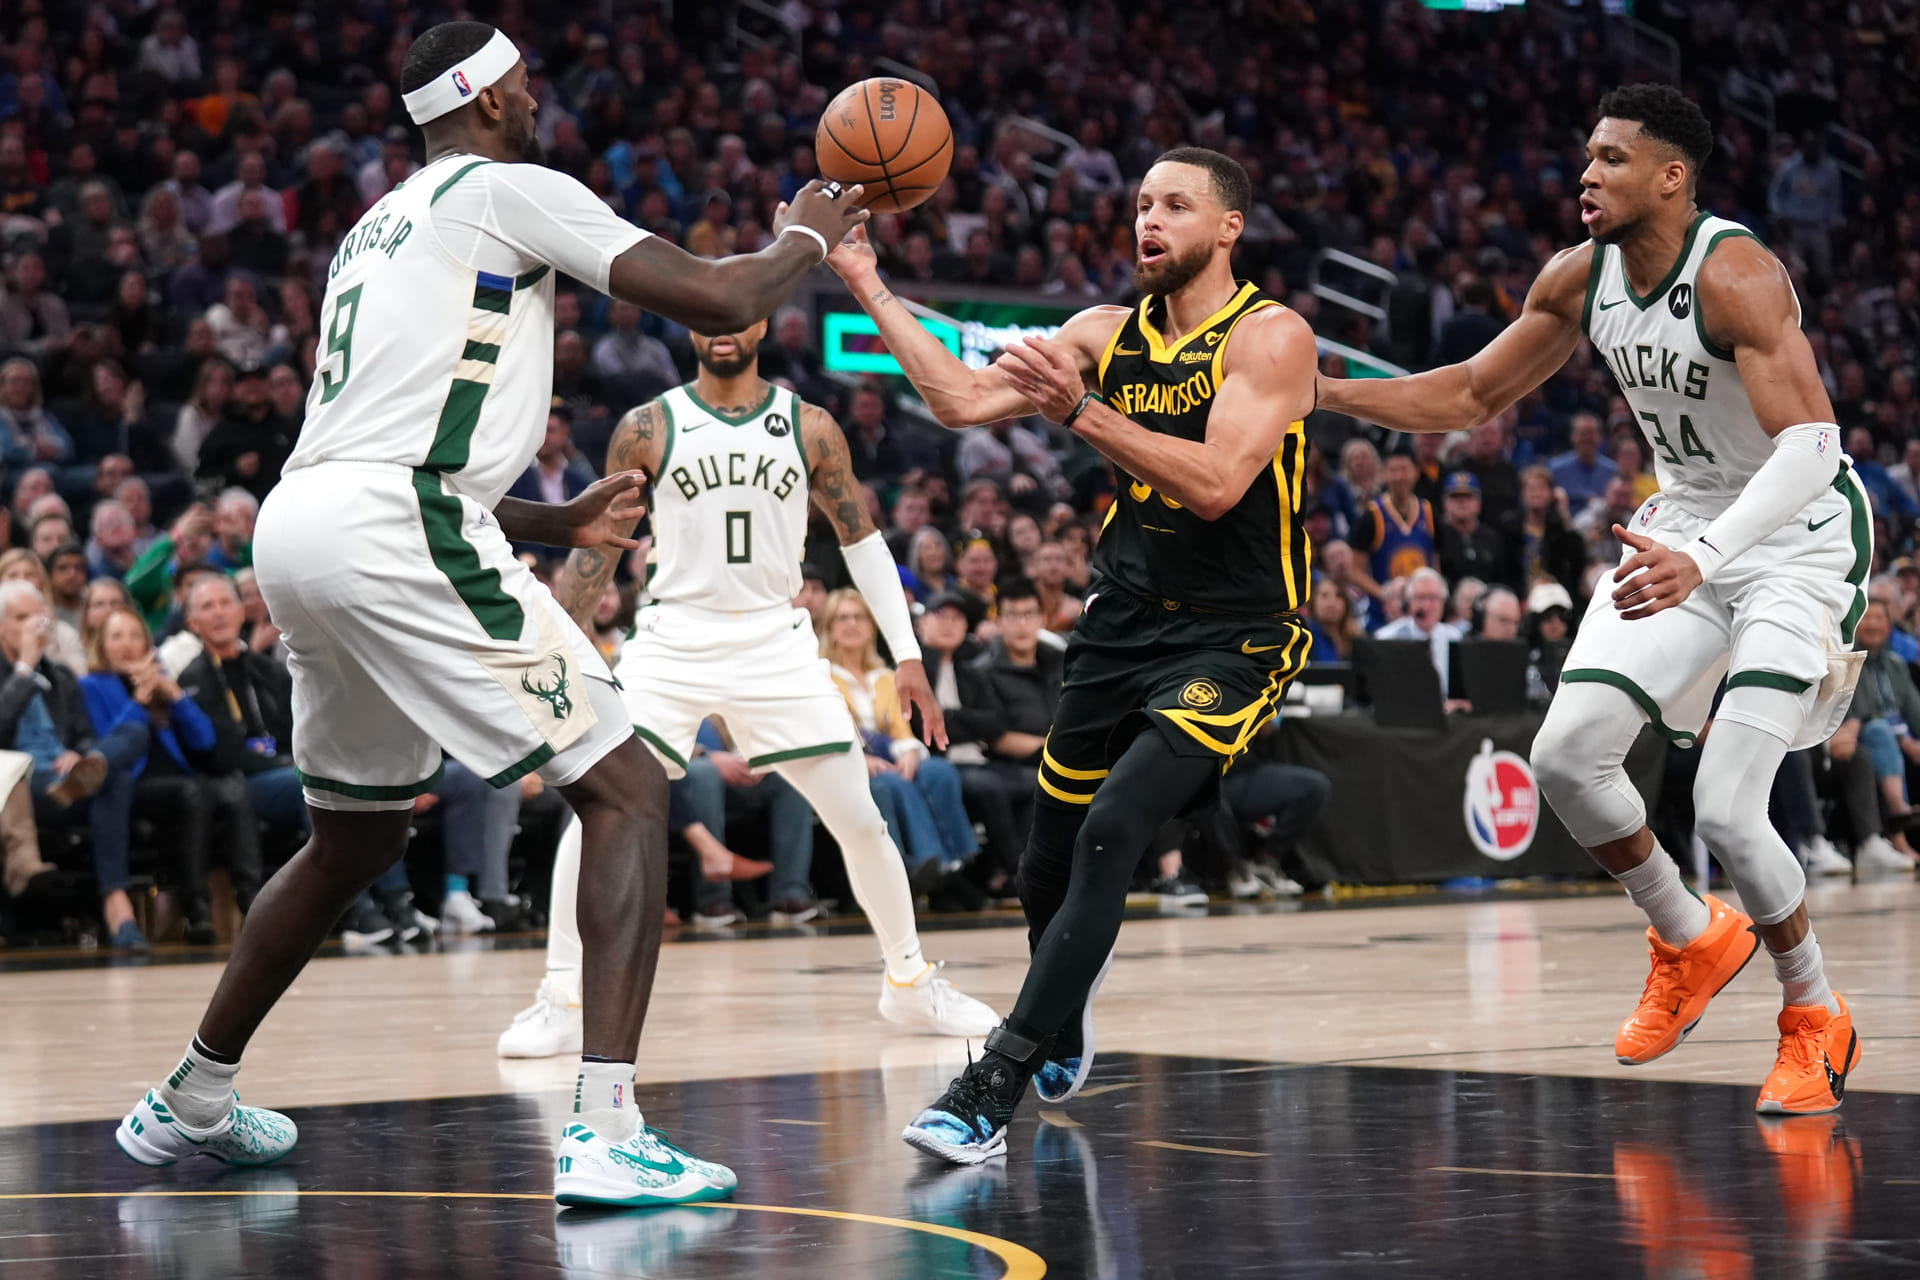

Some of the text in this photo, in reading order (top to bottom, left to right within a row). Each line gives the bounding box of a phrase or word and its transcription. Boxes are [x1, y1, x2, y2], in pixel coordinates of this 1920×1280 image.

[879, 80, 904, 121] lson
[380, 215, 413, 260] JR
[319, 281, 364, 406] 9
[1178, 350, 1213, 363] Rakuten
[1603, 344, 1710, 401] UCKS
[1638, 410, 1717, 467] 34
[671, 452, 801, 502] BUCKS
[725, 510, 752, 564] 0
